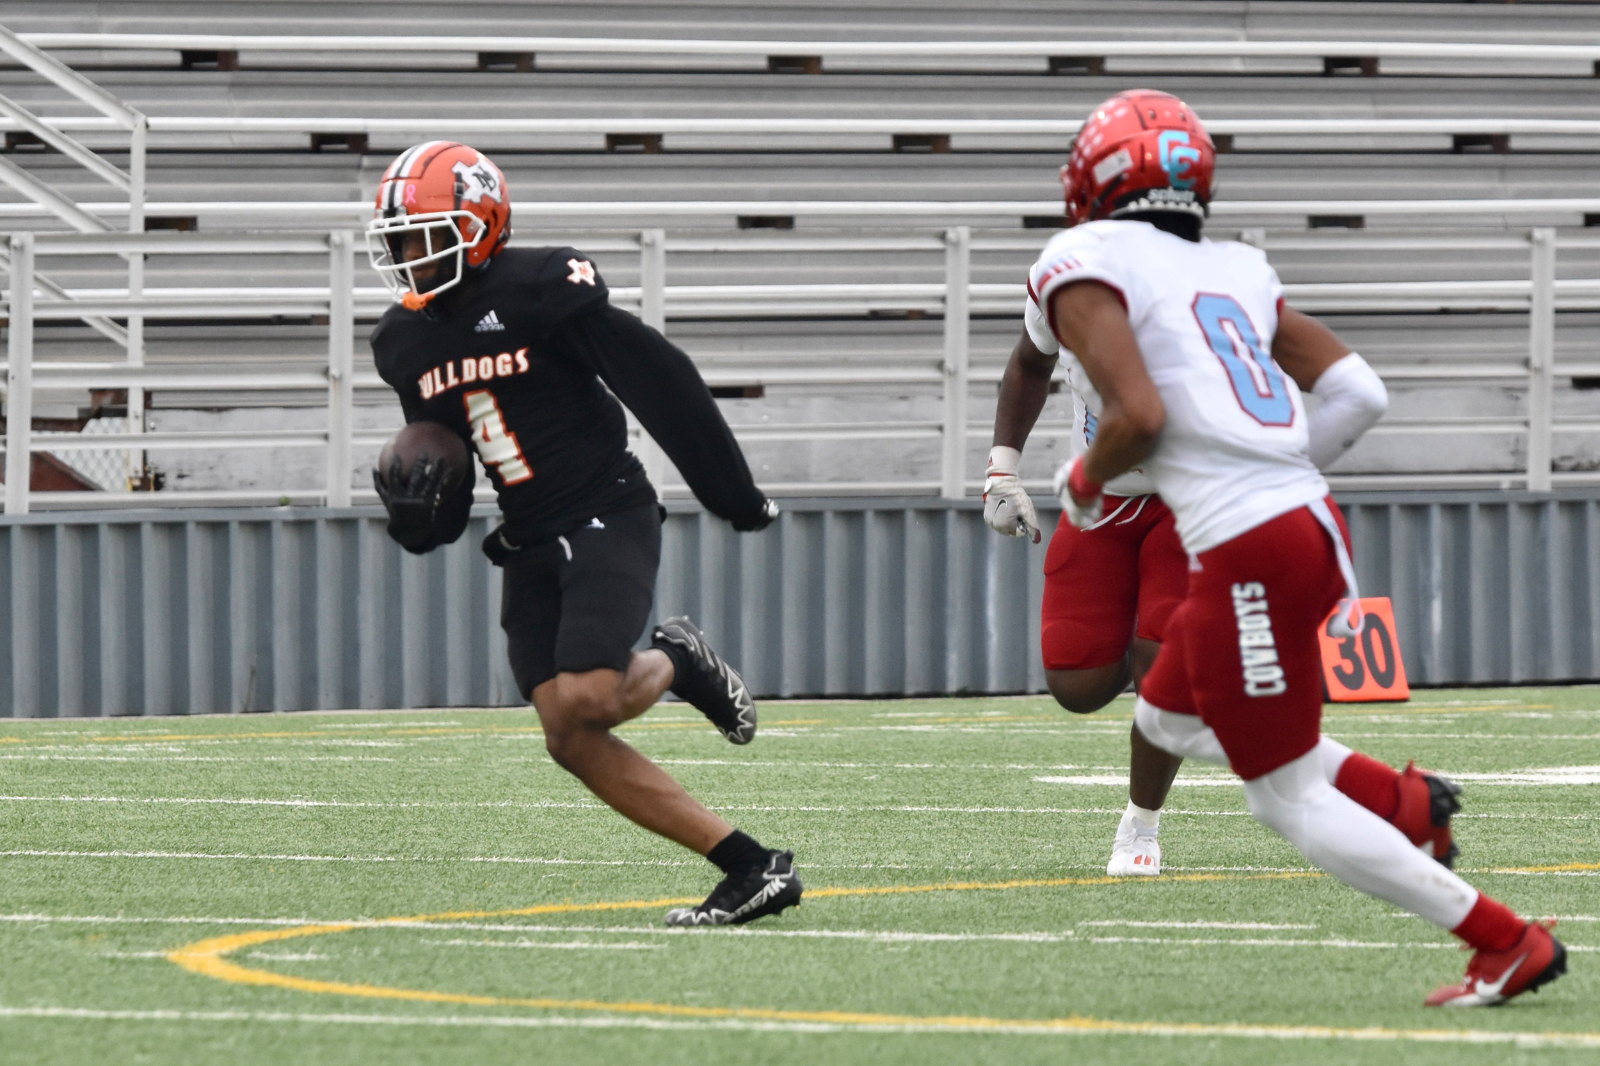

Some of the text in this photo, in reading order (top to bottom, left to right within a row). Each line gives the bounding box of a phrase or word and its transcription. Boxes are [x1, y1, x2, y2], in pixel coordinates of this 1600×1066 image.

[474, 322, 505, 332] adidas
[1190, 291, 1295, 427] 0
[417, 347, 528, 399] ULLDOGS
[463, 388, 533, 486] 4
[1231, 582, 1286, 696] COWBOYS
[1327, 612, 1396, 691] 30
